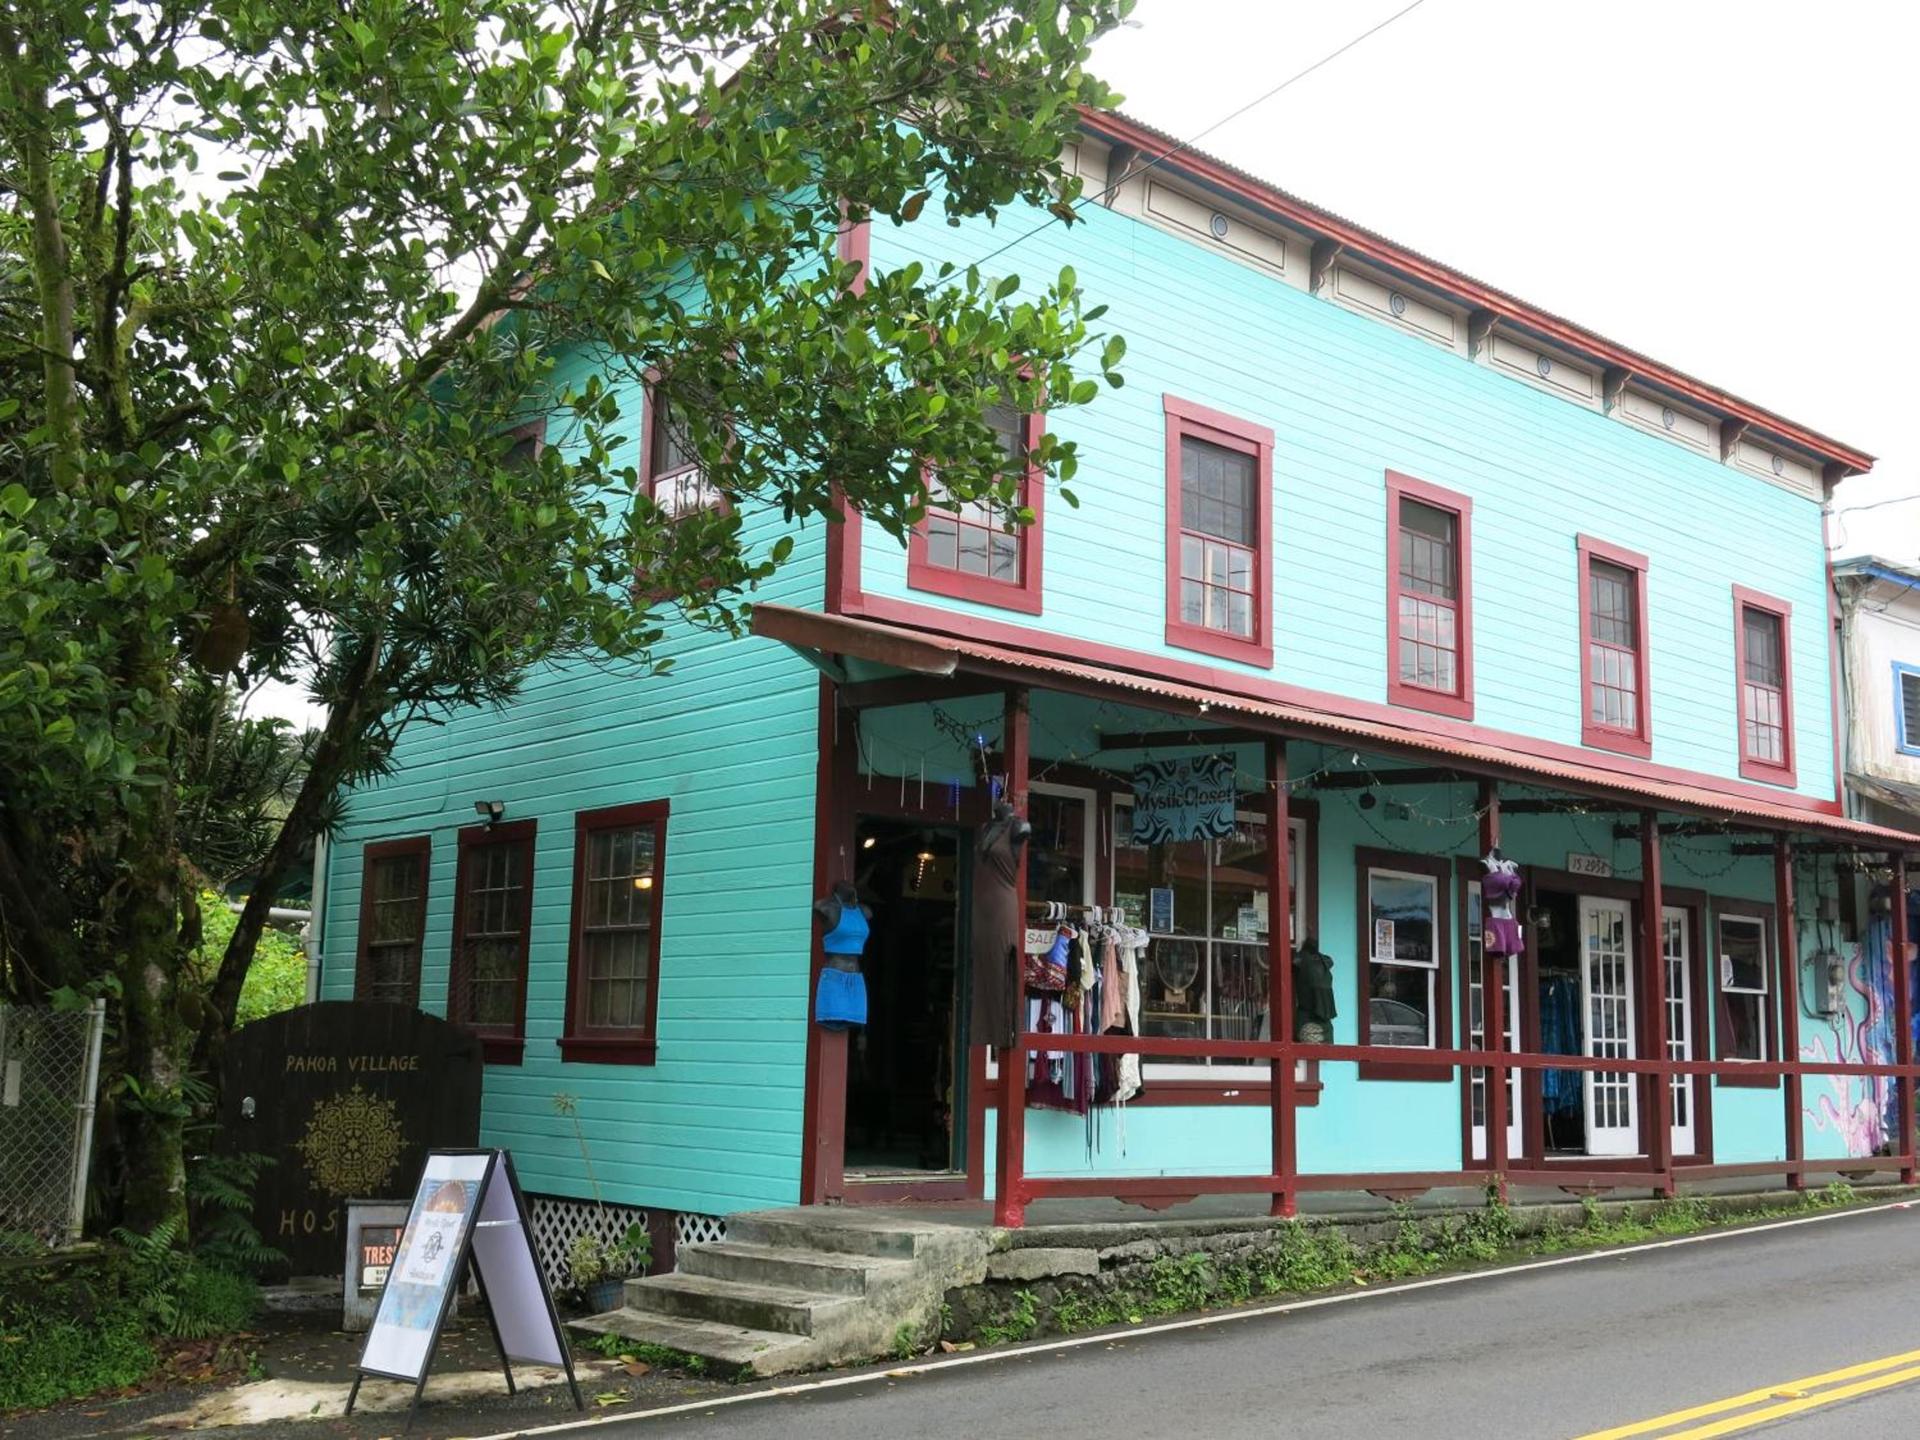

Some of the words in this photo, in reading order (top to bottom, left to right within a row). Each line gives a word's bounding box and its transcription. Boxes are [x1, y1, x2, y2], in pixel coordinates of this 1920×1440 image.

[1027, 932, 1057, 944] SALE
[285, 1055, 337, 1072] PAHOA
[347, 1055, 419, 1072] VILLAGE
[364, 1245, 396, 1265] TRES
